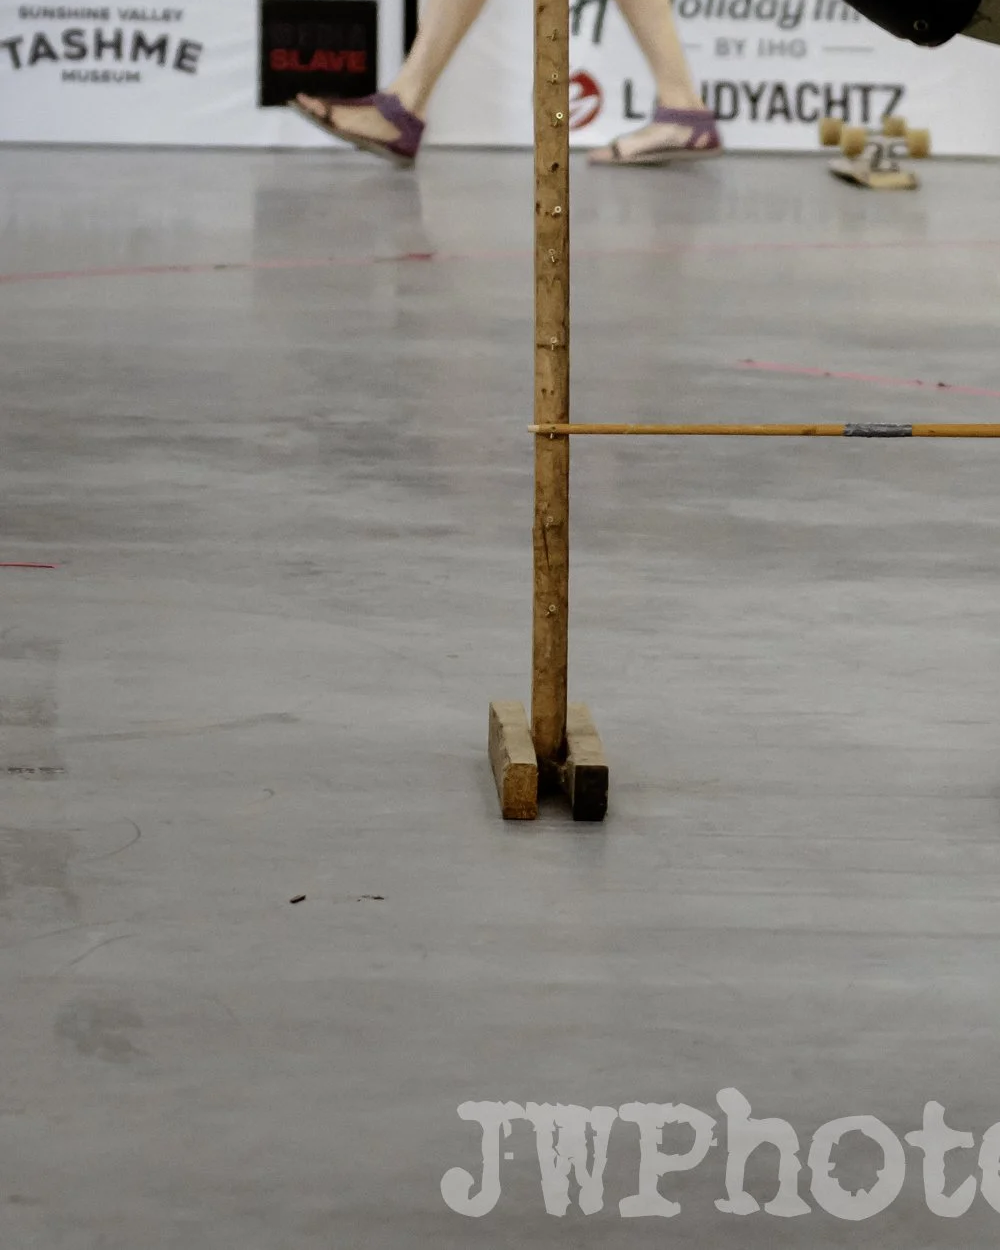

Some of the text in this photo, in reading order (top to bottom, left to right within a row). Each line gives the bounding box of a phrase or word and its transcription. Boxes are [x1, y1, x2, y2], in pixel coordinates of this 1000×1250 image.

[18, 4, 185, 23] SUNSHINE VALLEY
[0, 27, 204, 75] TASHME
[713, 36, 809, 59] BY IHG
[270, 48, 366, 73] SLAVE
[61, 68, 141, 84] MUSEUM
[622, 78, 906, 124] LDYACHTZ
